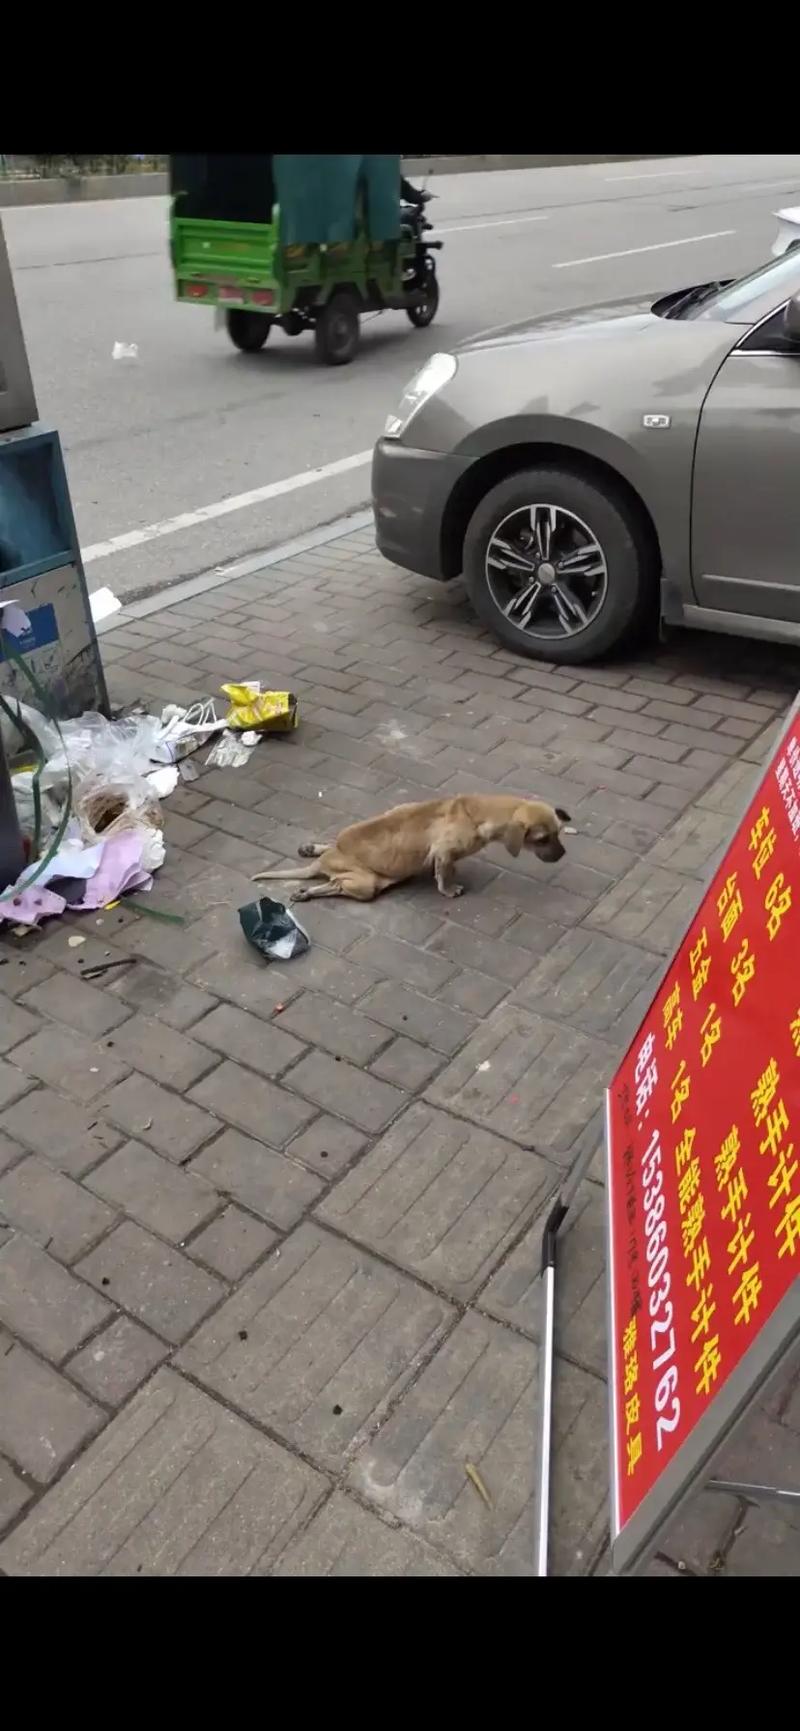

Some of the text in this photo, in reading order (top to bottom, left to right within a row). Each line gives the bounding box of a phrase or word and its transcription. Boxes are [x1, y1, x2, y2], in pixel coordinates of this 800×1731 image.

[716, 871, 800, 1259] 台面 3名 熟手计件
[748, 806, 792, 942] 车位 6名
[662, 981, 722, 1395] 高车 1名 全能熟手计件
[689, 926, 763, 1325] 五金 1名 熟手计件
[622, 1315, 643, 1476] 雅珞皮具
